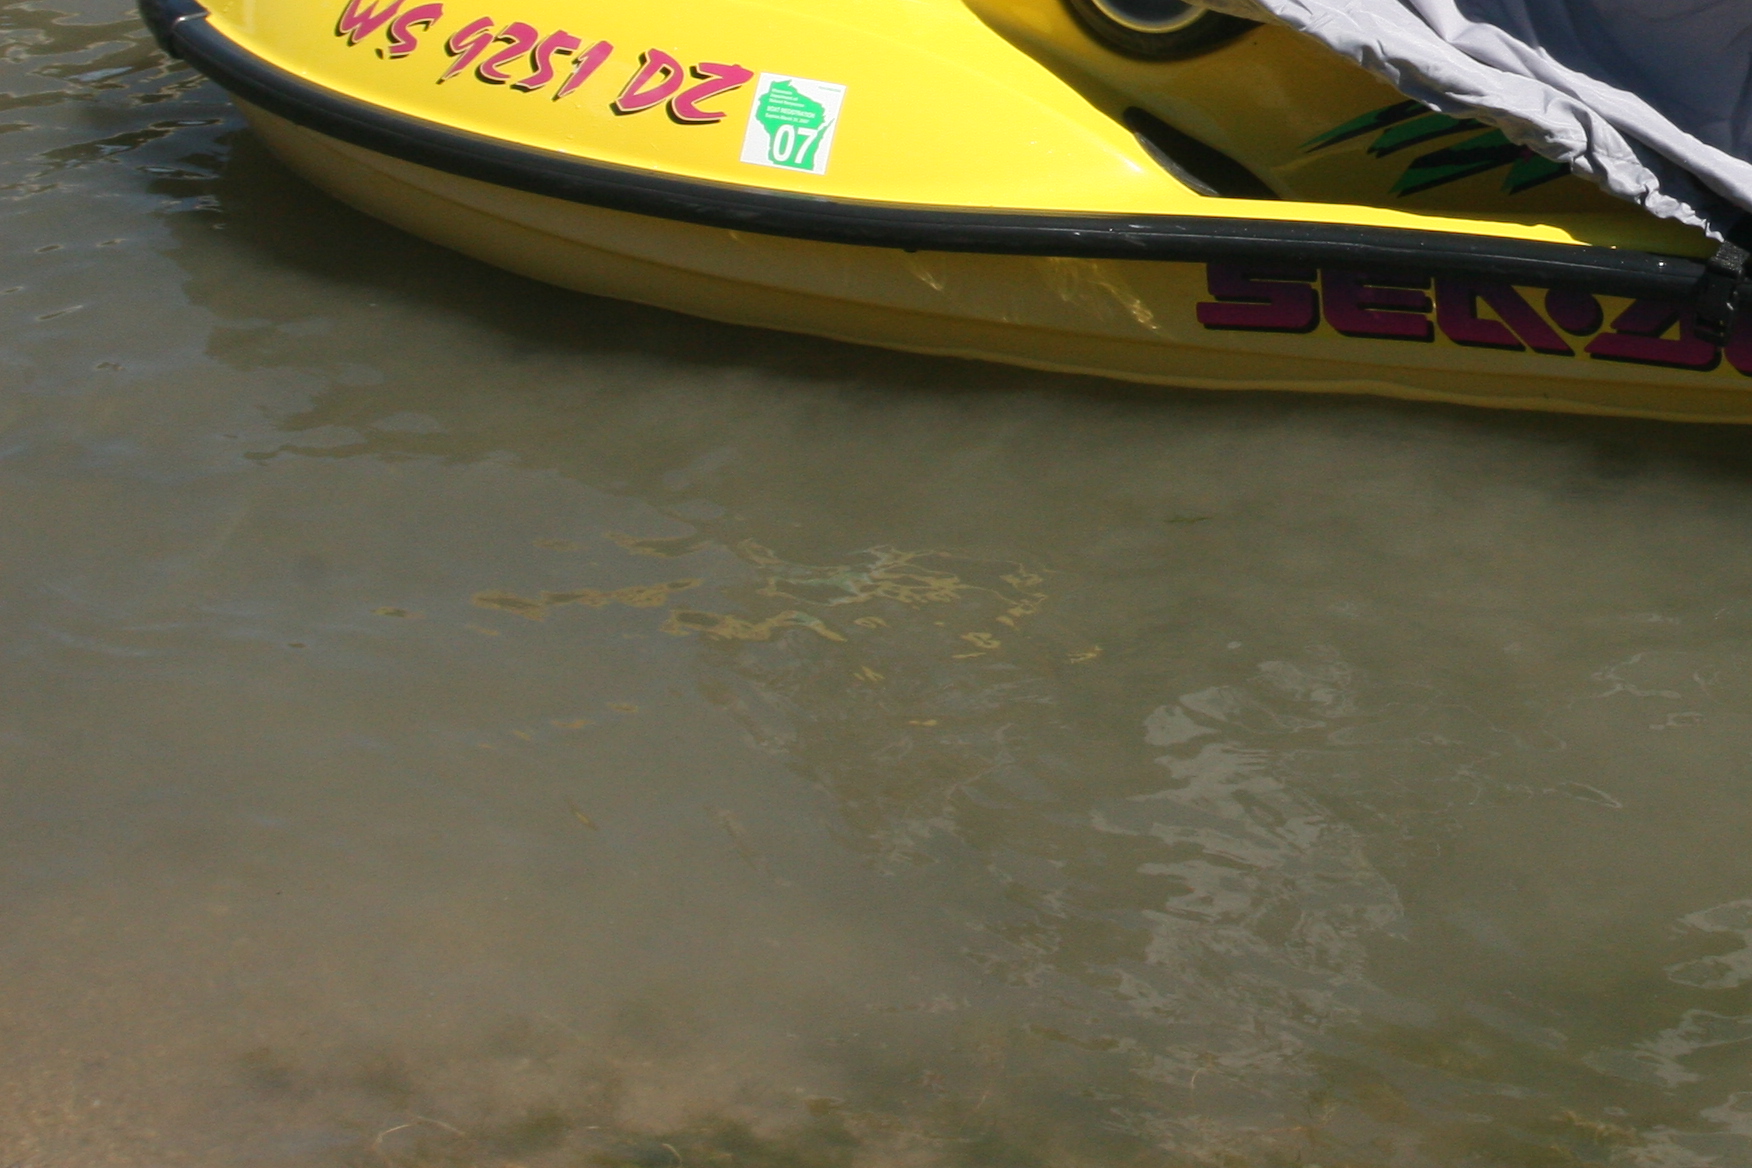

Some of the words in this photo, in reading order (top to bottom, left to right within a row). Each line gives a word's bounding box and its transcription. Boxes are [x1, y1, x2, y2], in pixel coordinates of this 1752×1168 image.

[437, 16, 613, 101] 9251
[610, 49, 754, 123] DZ
[773, 124, 818, 164] 07
